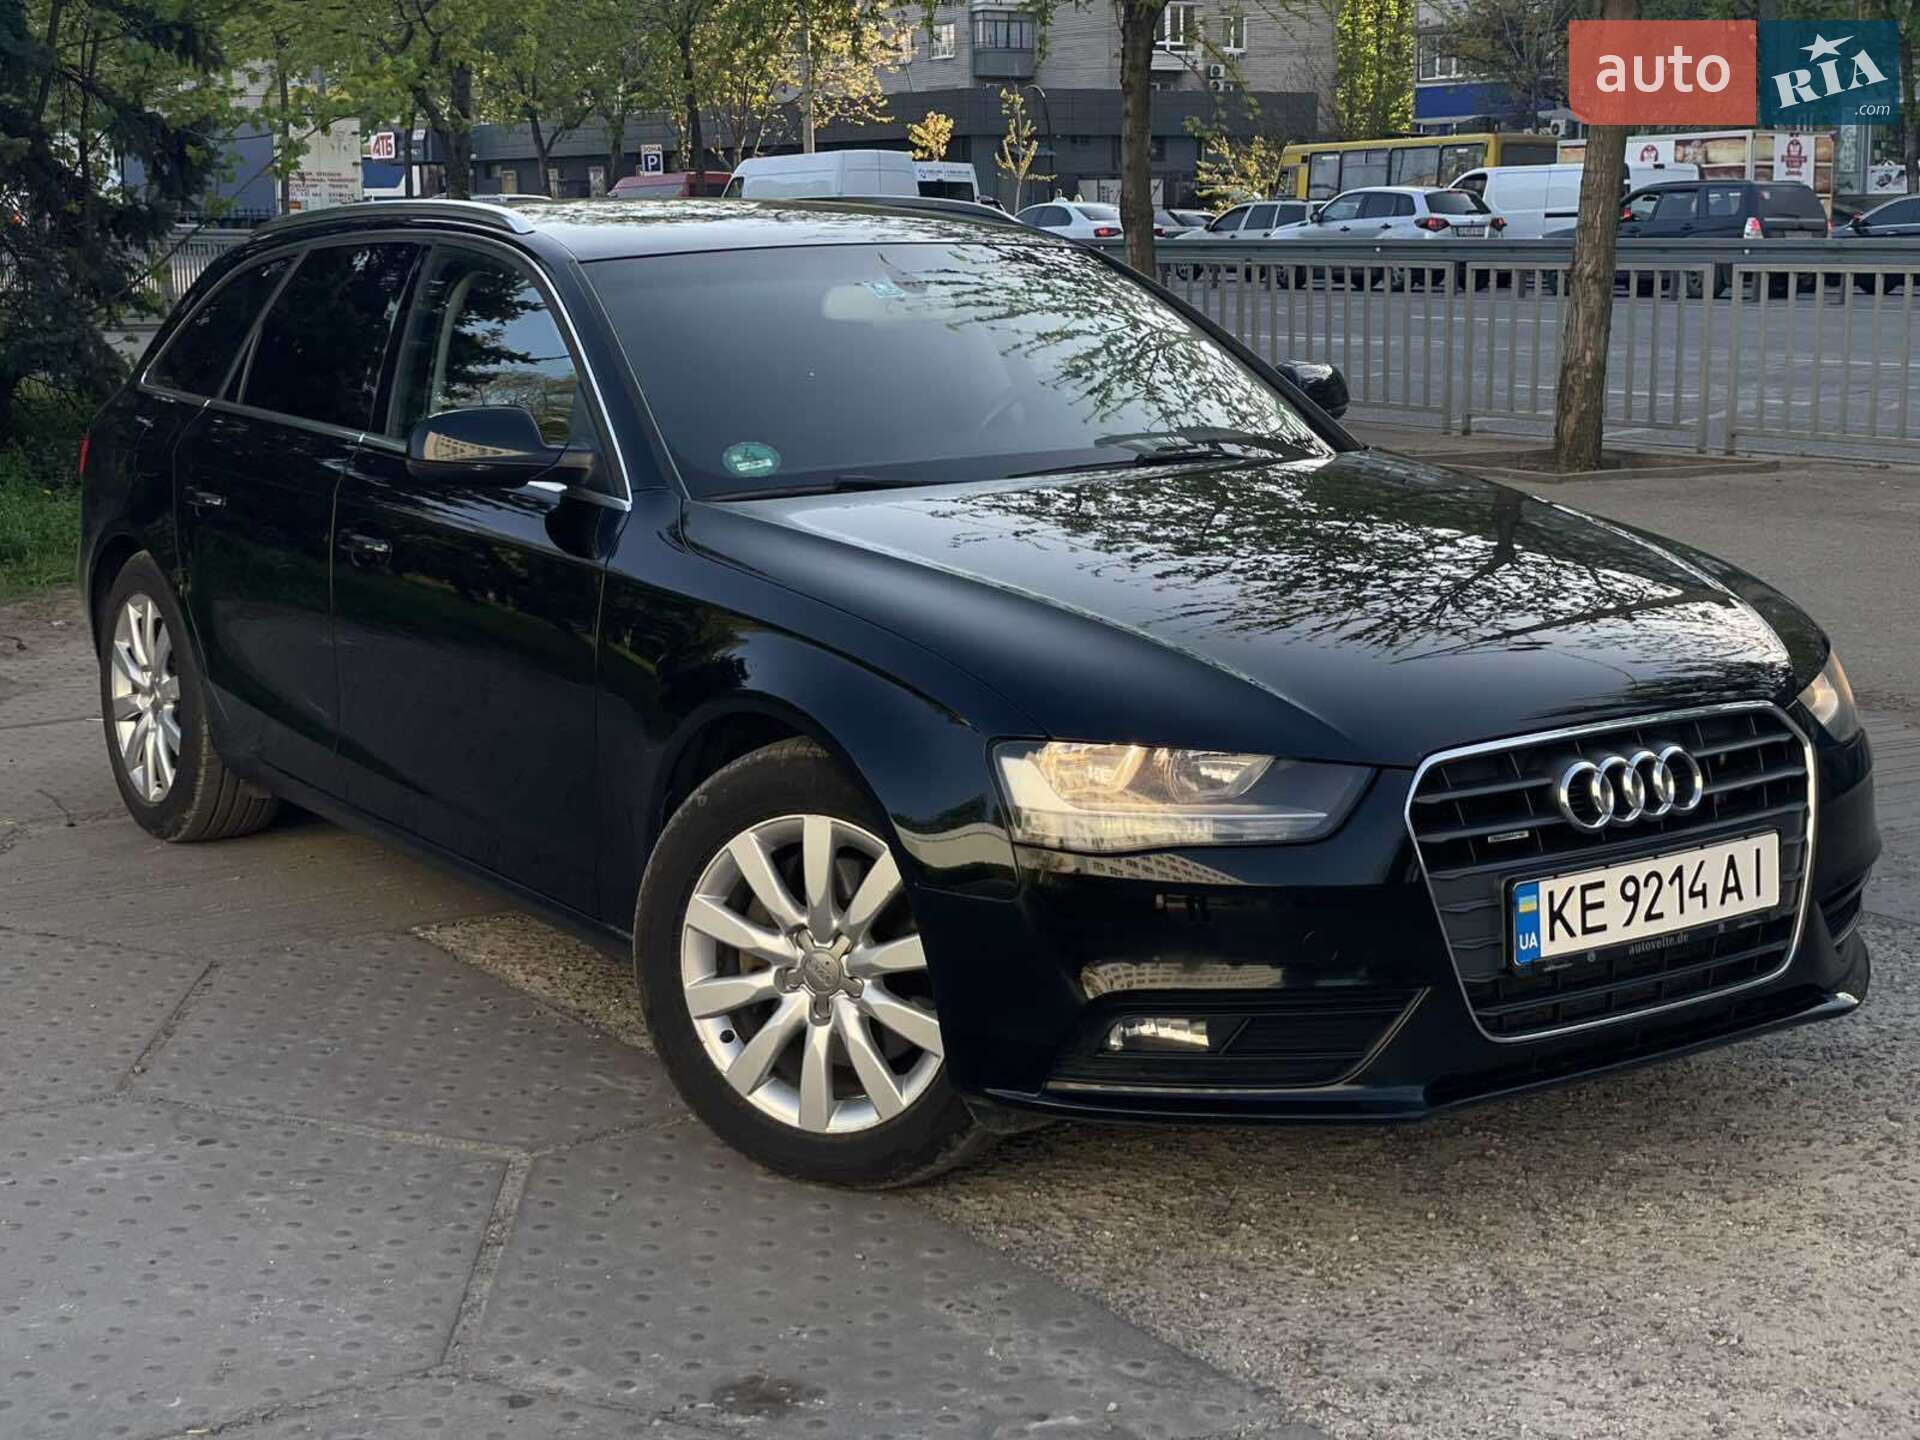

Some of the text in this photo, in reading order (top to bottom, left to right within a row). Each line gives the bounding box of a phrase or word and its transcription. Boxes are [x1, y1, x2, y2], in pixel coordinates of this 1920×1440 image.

[372, 134, 394, 157] АТБ
[647, 155, 658, 170] P
[1547, 847, 1762, 942] KE 9214 AI
[1518, 932, 1539, 951] UA
